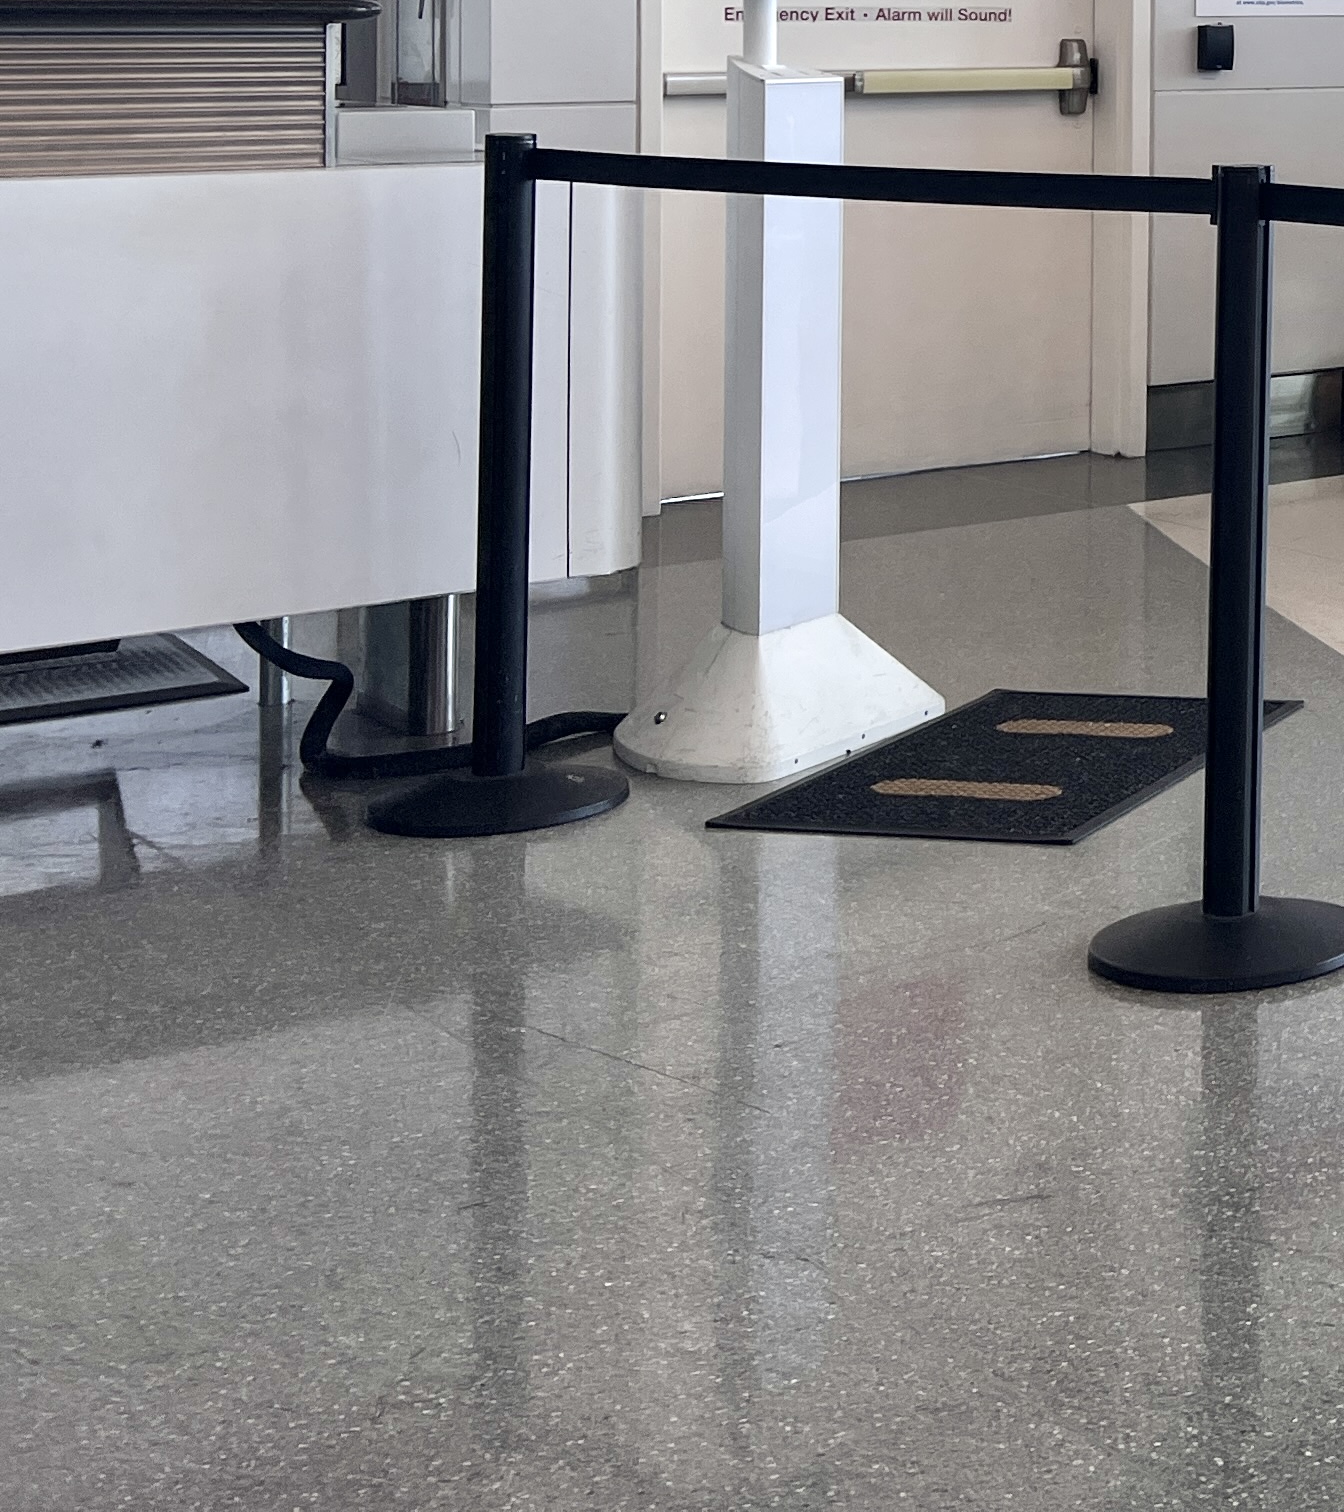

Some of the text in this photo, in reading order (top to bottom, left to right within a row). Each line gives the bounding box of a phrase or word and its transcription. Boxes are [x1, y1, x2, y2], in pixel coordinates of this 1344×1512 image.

[824, 7, 855, 21] Exit
[875, 7, 921, 21] Alarm
[927, 7, 953, 21] will
[957, 7, 1013, 22] Sound!
